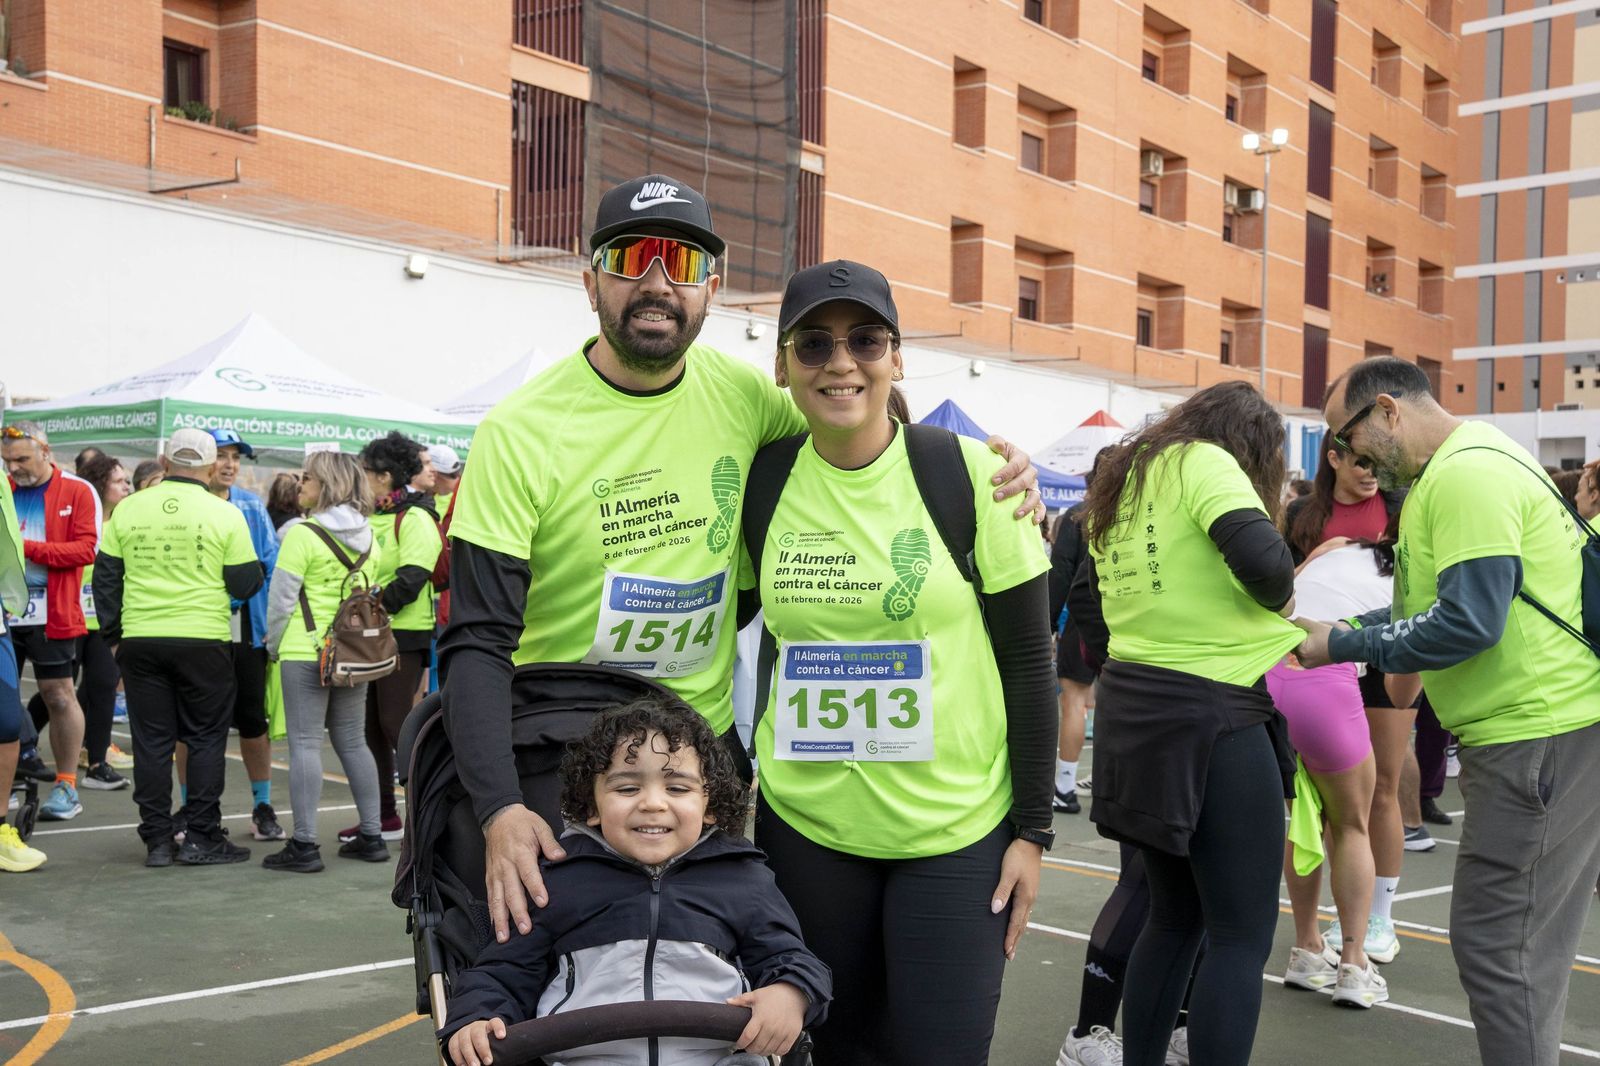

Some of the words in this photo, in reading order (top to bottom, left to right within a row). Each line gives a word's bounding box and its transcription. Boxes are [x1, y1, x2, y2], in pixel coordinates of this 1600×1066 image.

[639, 181, 679, 199] NIKE
[829, 267, 850, 287] S
[47, 415, 84, 433] ESPAÑOLA
[85, 414, 114, 429] CONTRA
[115, 414, 125, 428] EL
[125, 410, 157, 427] CÁNCER
[172, 412, 273, 435] ASOCIACIÓN
[276, 418, 354, 440] ESPAÑOLA
[436, 433, 471, 449] CÁNC
[1042, 487, 1055, 500] DE
[1059, 488, 1086, 501] ALME
[600, 503, 611, 518] II
[615, 490, 681, 516] Almería
[602, 521, 620, 532] en
[623, 510, 674, 529] marcha
[602, 530, 646, 547] contra
[649, 525, 662, 537] el
[665, 517, 708, 534] cáncer
[604, 552, 610, 560] 8
[612, 550, 623, 558] de
[625, 544, 656, 556] febrero
[657, 540, 667, 548] de
[668, 535, 691, 546] 2026
[779, 551, 789, 564] II
[791, 552, 856, 565] Almería
[775, 567, 789, 576] en
[793, 567, 845, 577] marcha
[622, 582, 629, 592] II
[631, 583, 676, 597] Almería
[677, 589, 690, 597] en
[691, 580, 717, 596] marcha
[773, 579, 813, 590] contra
[817, 579, 830, 590] el
[833, 580, 883, 591] cáncer
[625, 598, 662, 609] contra
[664, 600, 674, 609] el
[677, 595, 705, 609] cáncer
[775, 596, 780, 604] 8
[781, 596, 789, 604] de
[791, 595, 823, 604] febrero
[825, 596, 836, 604] de
[839, 596, 862, 605] 2026
[609, 611, 716, 653] 1514
[800, 650, 841, 661] Almería
[843, 653, 858, 661] en
[861, 650, 908, 661] marcha
[796, 664, 831, 675] contra
[833, 665, 844, 675] el
[847, 664, 890, 675] cáncer
[788, 687, 921, 730] 1513
